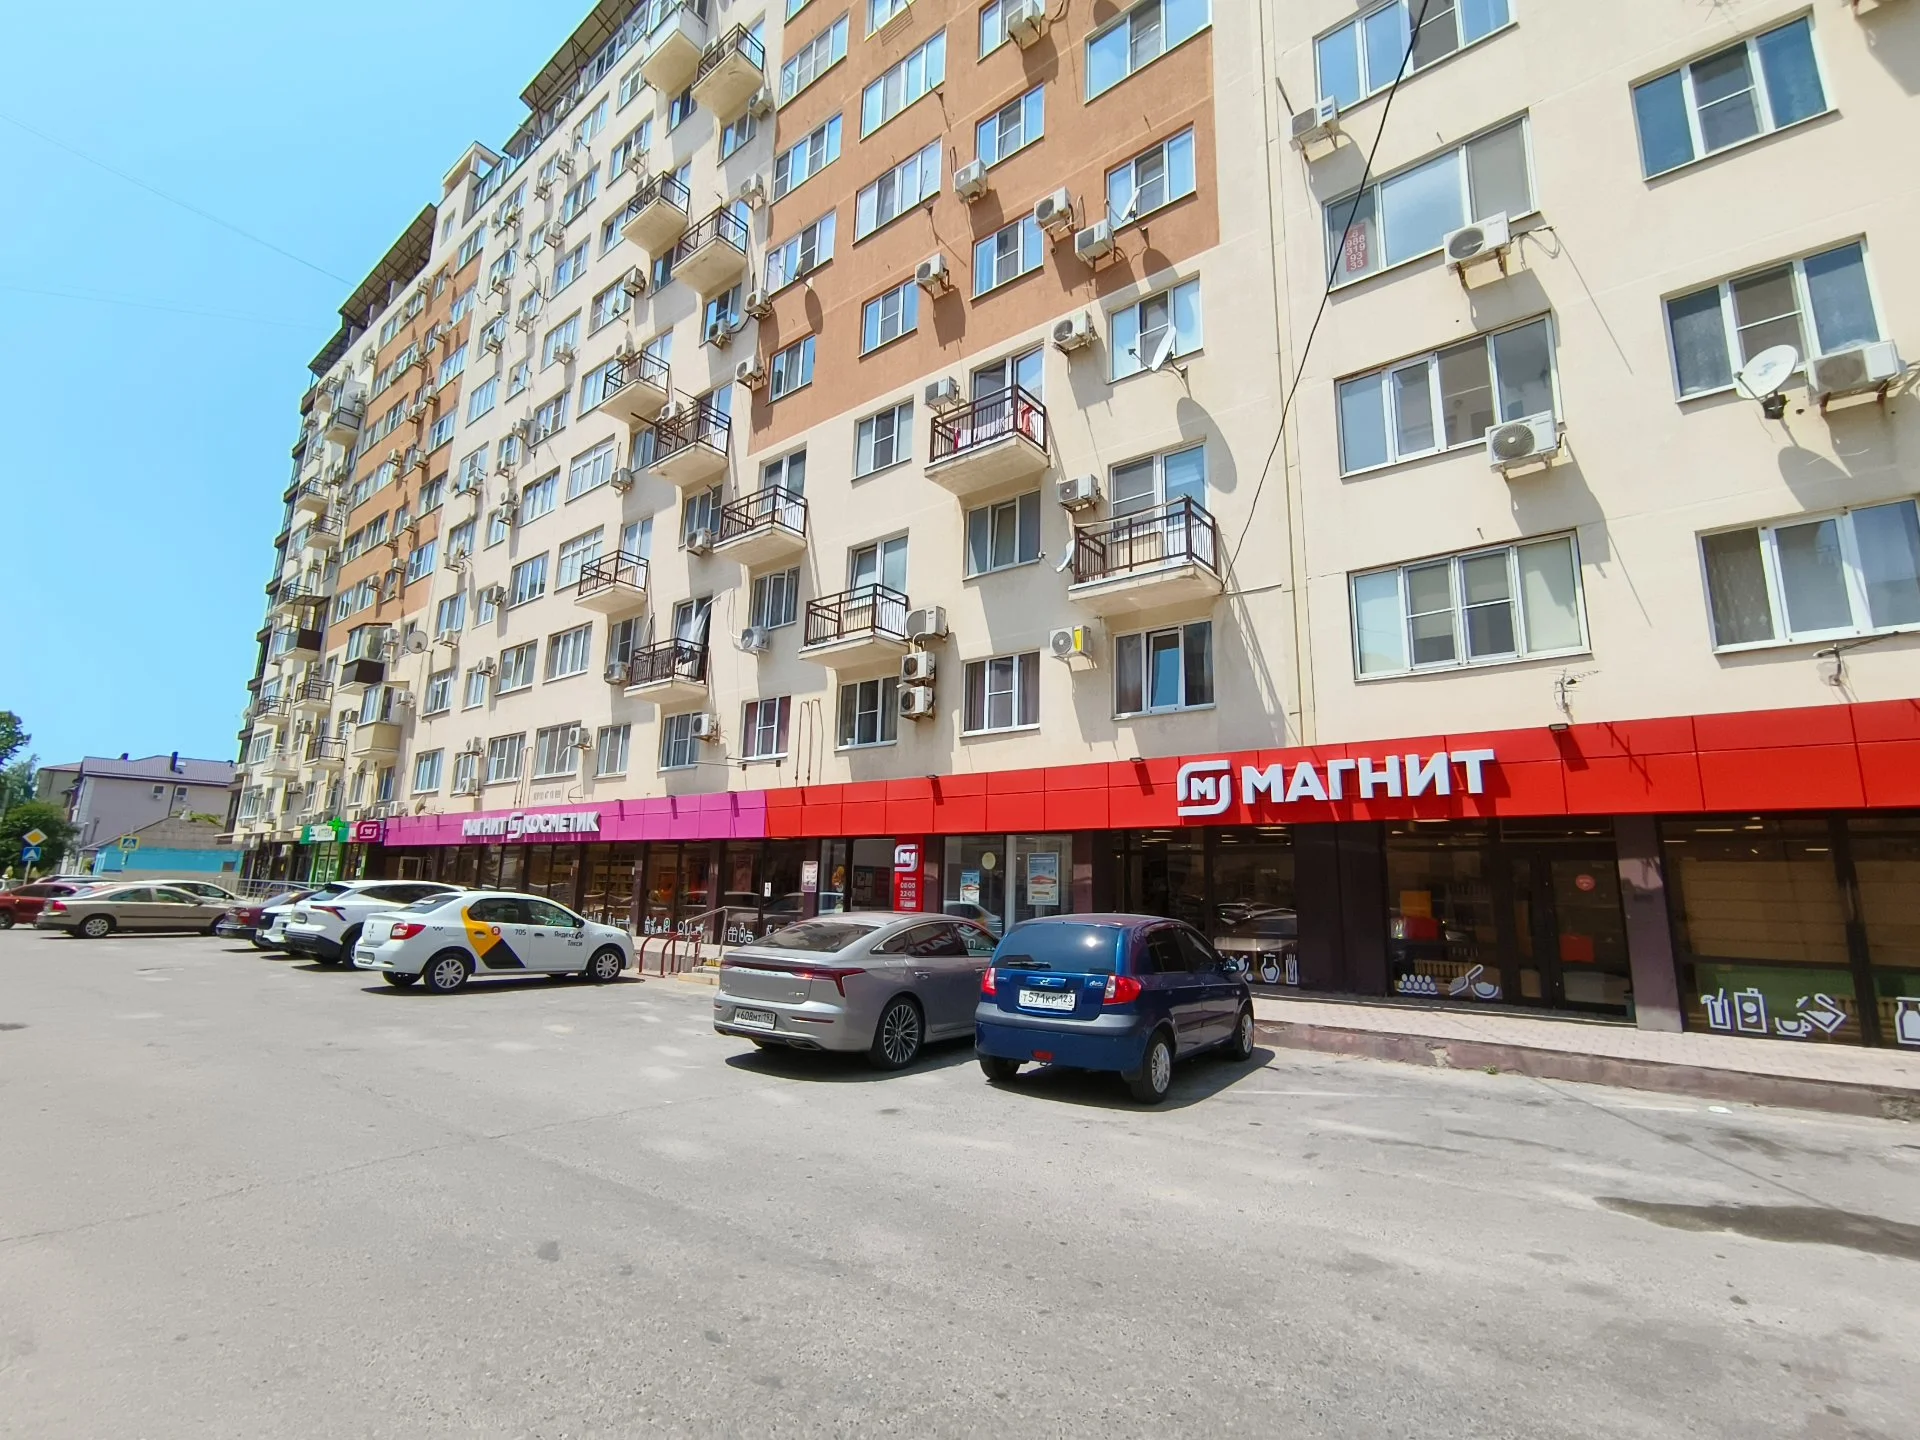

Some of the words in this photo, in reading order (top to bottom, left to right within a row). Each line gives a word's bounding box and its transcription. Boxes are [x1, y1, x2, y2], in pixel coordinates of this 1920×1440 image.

[1346, 234, 1365, 247] 988
[1346, 243, 1366, 256] 319
[1350, 251, 1363, 262] 93
[1350, 259, 1364, 270] 33
[1241, 748, 1495, 805] МАГНИТ
[463, 817, 506, 836] МАГНИТ
[523, 811, 600, 832] КОСМЕТИК
[514, 928, 527, 936] 705
[554, 930, 575, 939] Яндекс
[1022, 991, 1057, 1004] Т571КР
[1058, 994, 1073, 1004] 123
